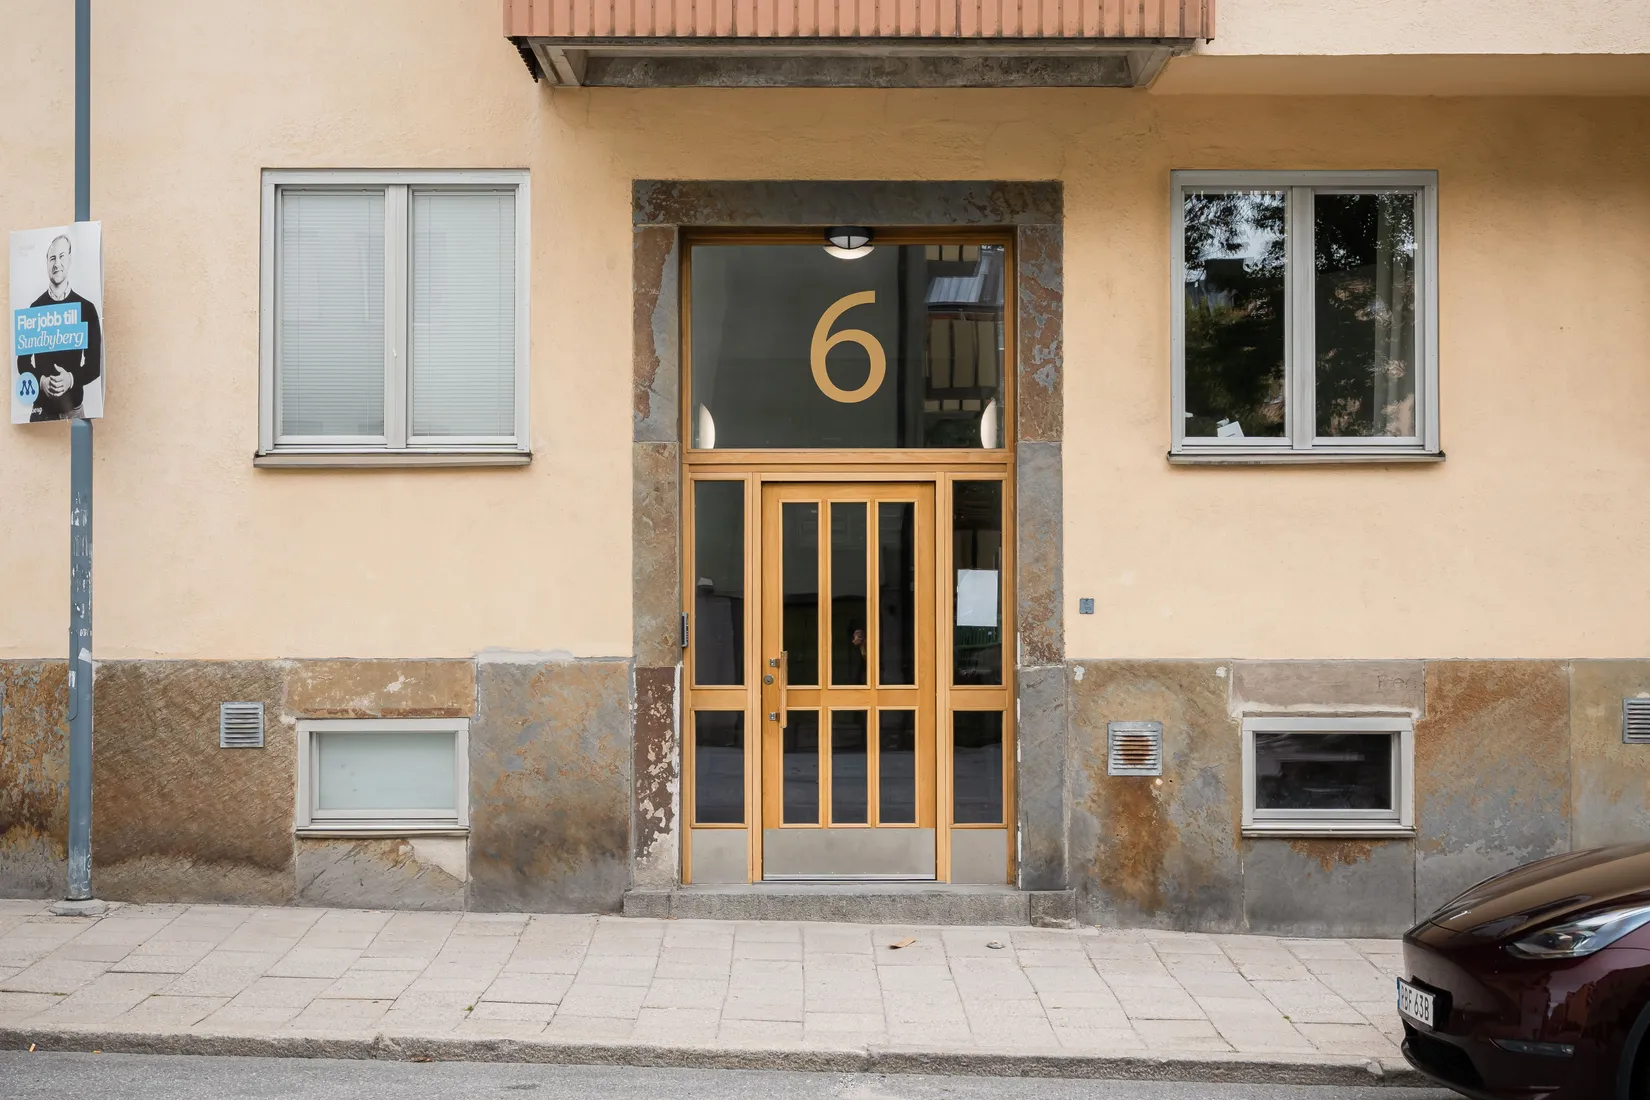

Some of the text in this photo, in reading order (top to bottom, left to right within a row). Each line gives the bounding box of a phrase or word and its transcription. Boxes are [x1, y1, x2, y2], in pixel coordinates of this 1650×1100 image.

[18, 309, 77, 331] Fler jobb till
[18, 329, 84, 349] Sundbyberg
[810, 290, 887, 404] 6
[1414, 993, 1430, 1021] 63B
